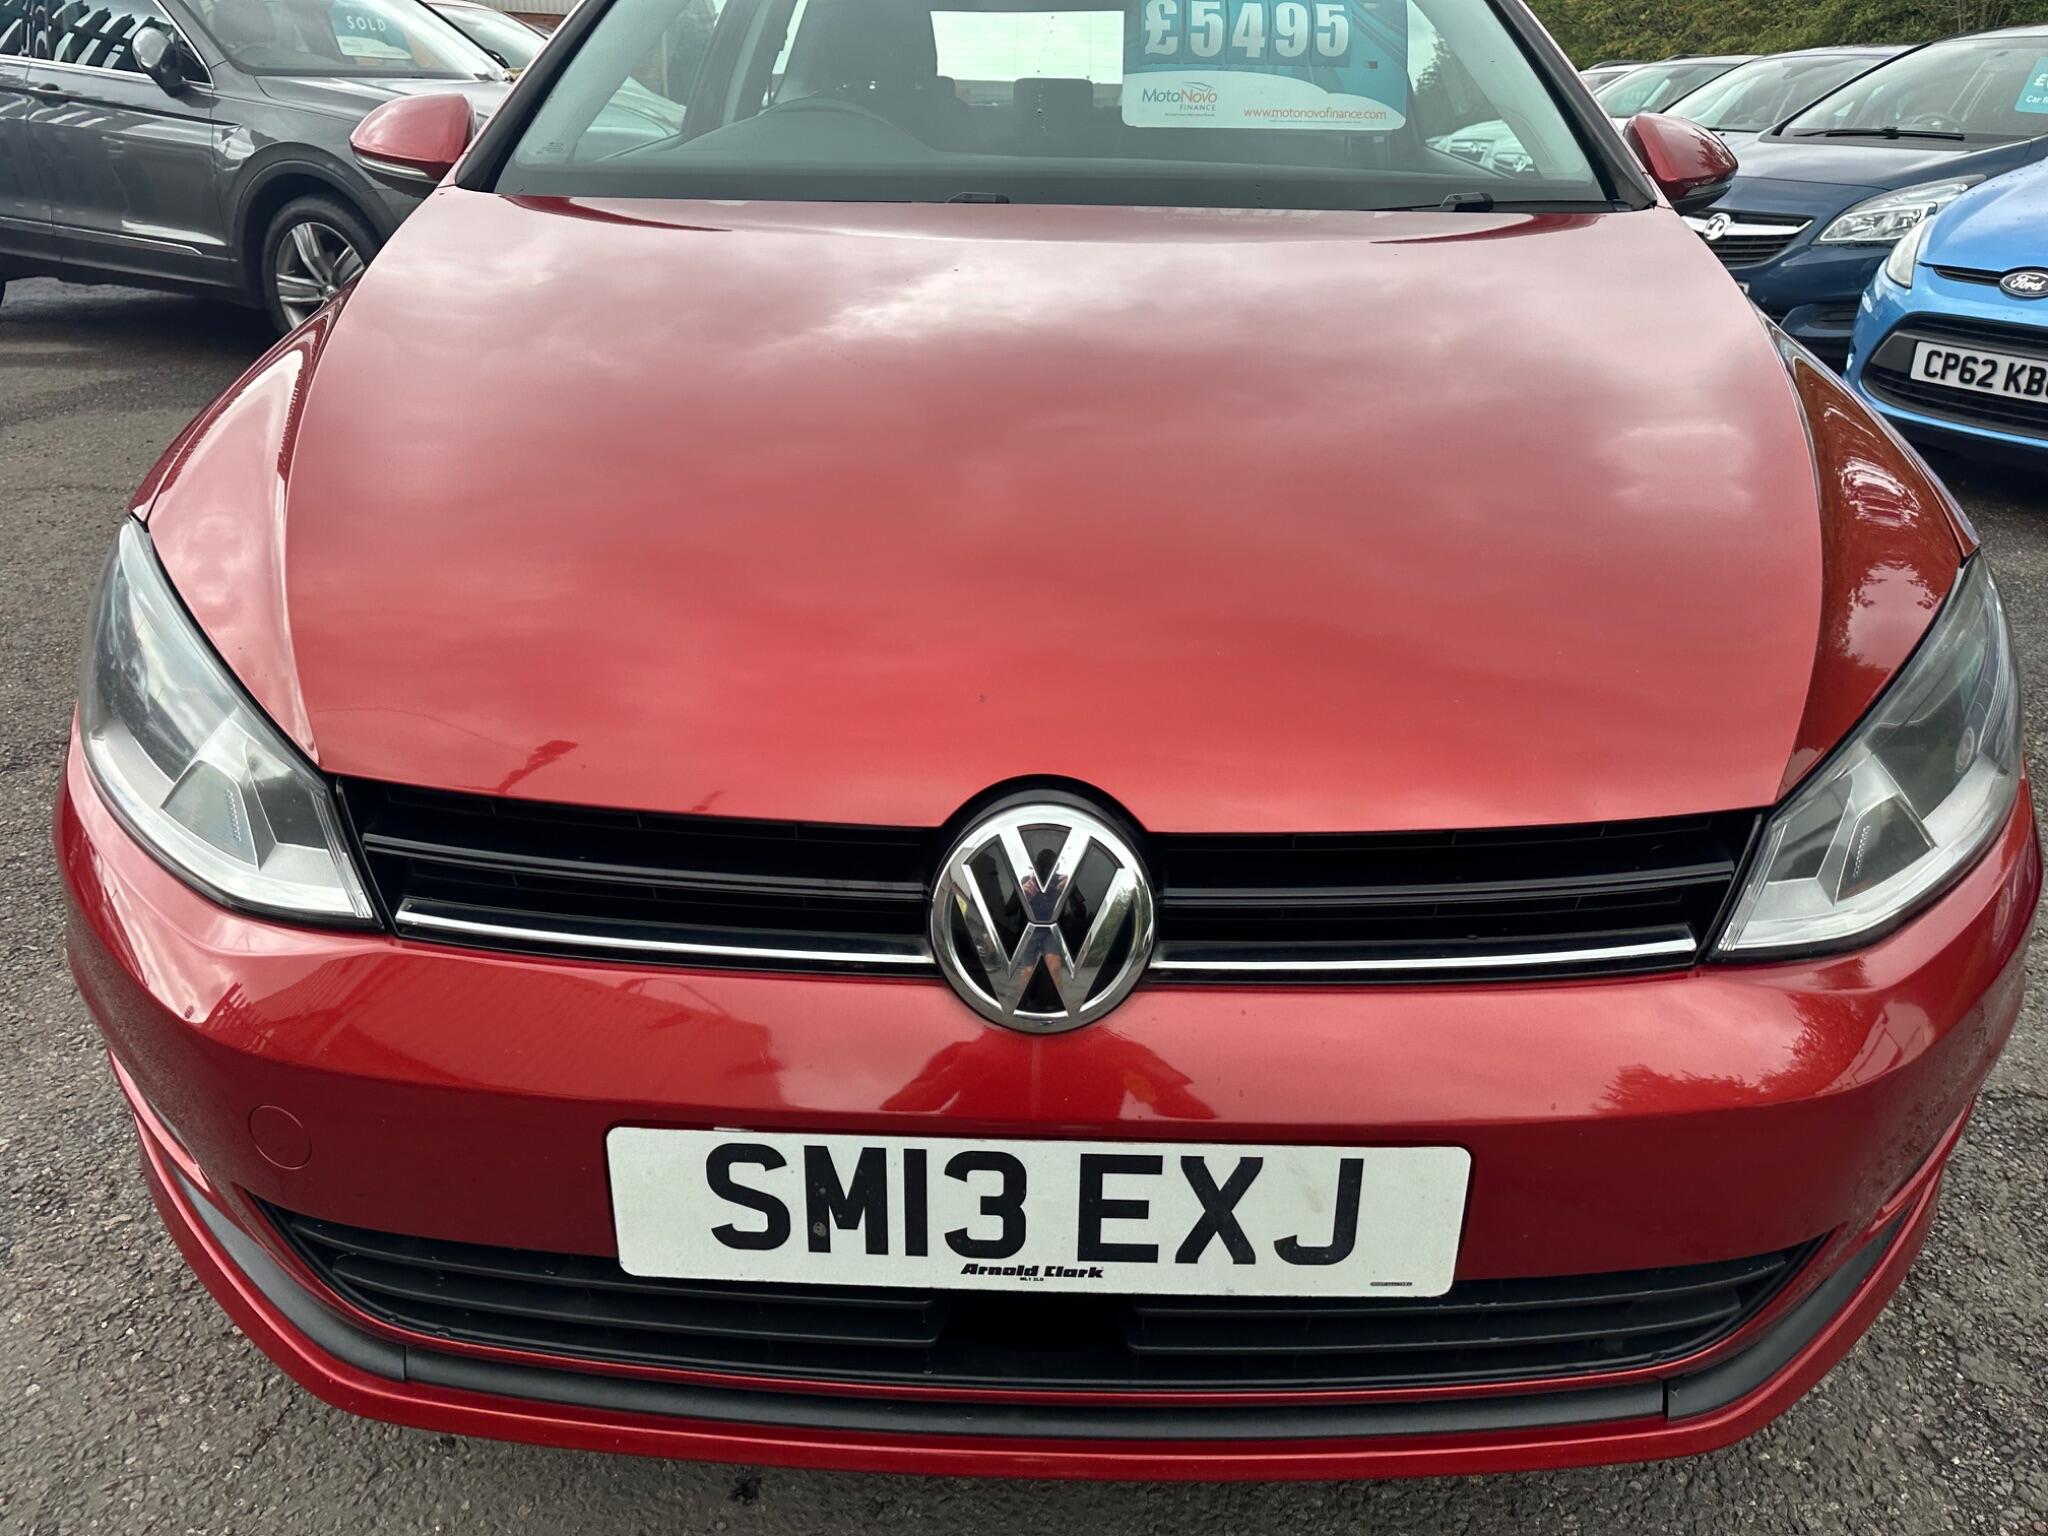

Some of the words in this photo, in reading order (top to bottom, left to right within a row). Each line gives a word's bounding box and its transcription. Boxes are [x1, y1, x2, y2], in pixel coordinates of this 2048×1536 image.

[346, 15, 386, 31] SOLD
[1144, 0, 1349, 58] £5495
[1142, 88, 1218, 103] MotoNovo
[1243, 107, 1387, 120] www.motonovofinance.com
[2010, 274, 2046, 291] Ford
[1924, 350, 1998, 388] CP62
[2002, 363, 2048, 396] KB
[706, 1143, 1028, 1258] SM13
[1078, 1153, 1364, 1266] EXJ
[960, 1263, 1039, 1277] Arnold
[1044, 1265, 1104, 1278] Clark
